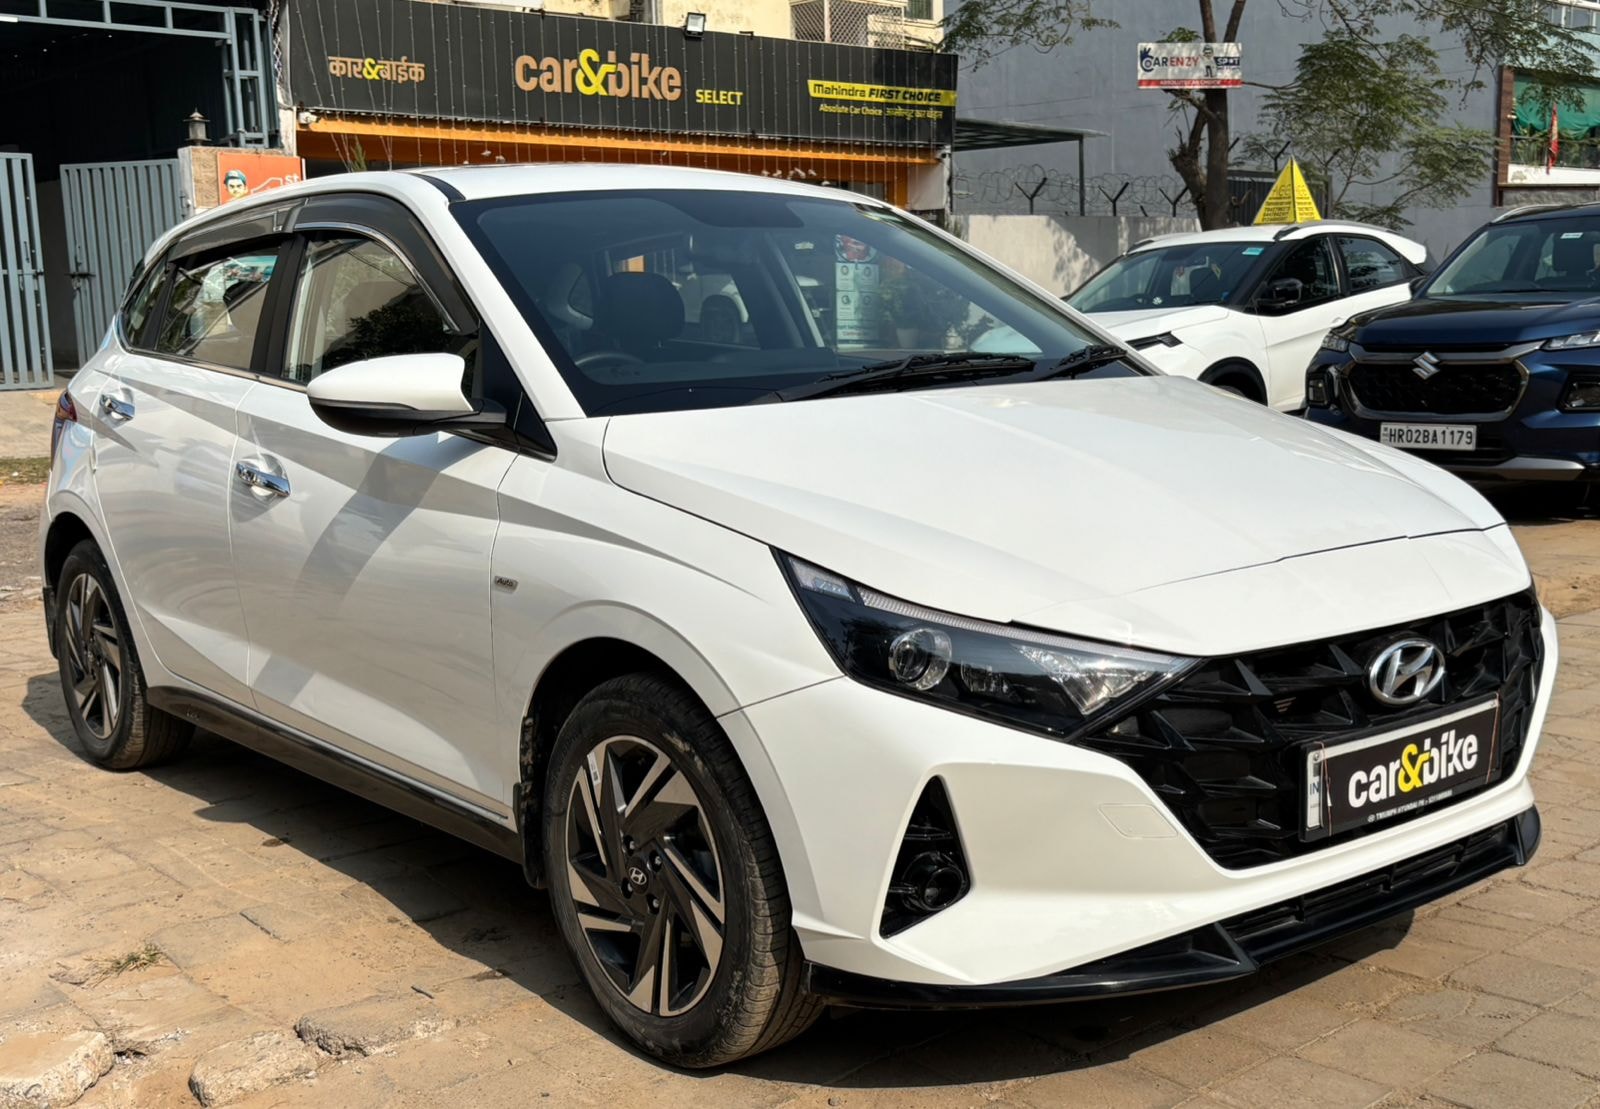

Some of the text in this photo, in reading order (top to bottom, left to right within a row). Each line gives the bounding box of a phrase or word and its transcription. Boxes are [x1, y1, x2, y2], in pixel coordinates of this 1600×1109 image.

[328, 56, 425, 83] कार&बाईक
[1140, 54, 1200, 72] CARENZY
[515, 48, 682, 101] car&bike
[695, 89, 743, 105] SELECT
[813, 83, 942, 102] Mahindra FIRST CHOICE
[819, 103, 883, 116] Absolute Car Choice
[1389, 428, 1473, 445] HR02BA1179
[1348, 729, 1478, 808] car&bike
[1309, 782, 1320, 796] IN
